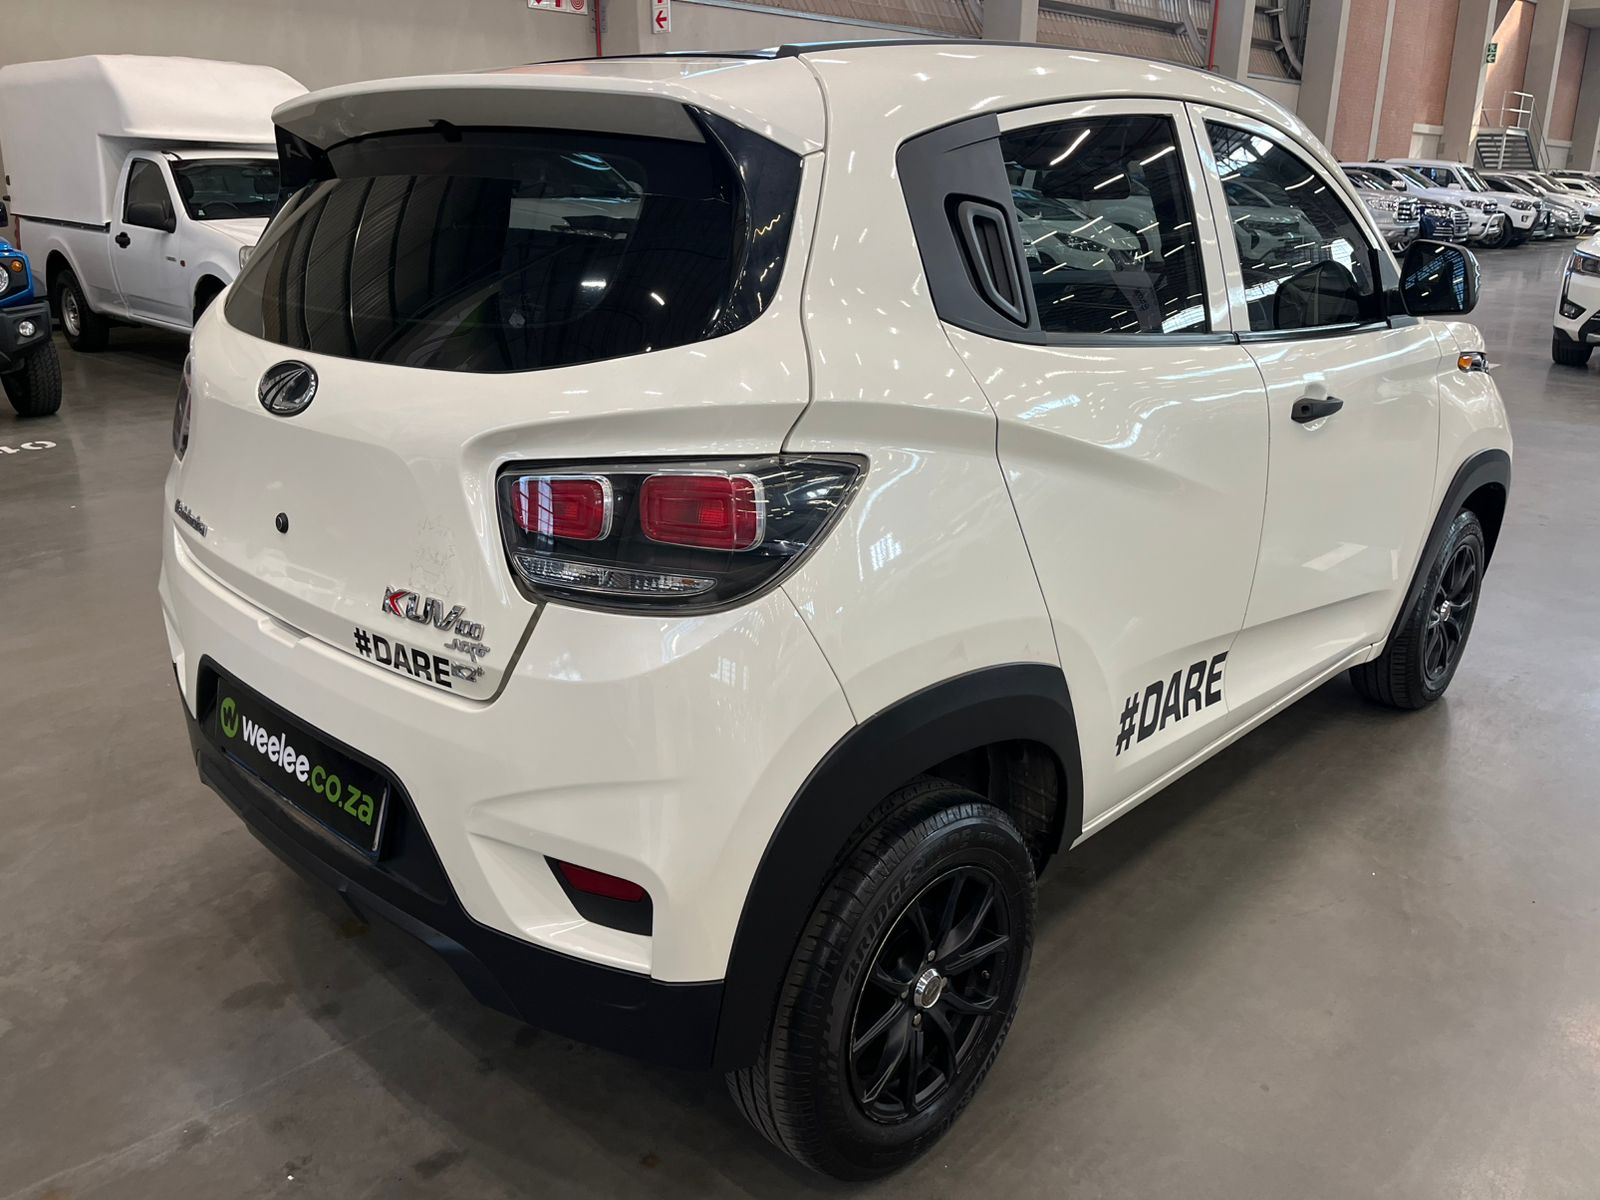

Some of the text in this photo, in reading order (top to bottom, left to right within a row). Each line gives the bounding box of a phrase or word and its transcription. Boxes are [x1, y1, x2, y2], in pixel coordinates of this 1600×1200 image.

[353, 626, 453, 689] #DARE
[1116, 650, 1230, 757] #DARE
[241, 715, 375, 827] weelee.co.za
